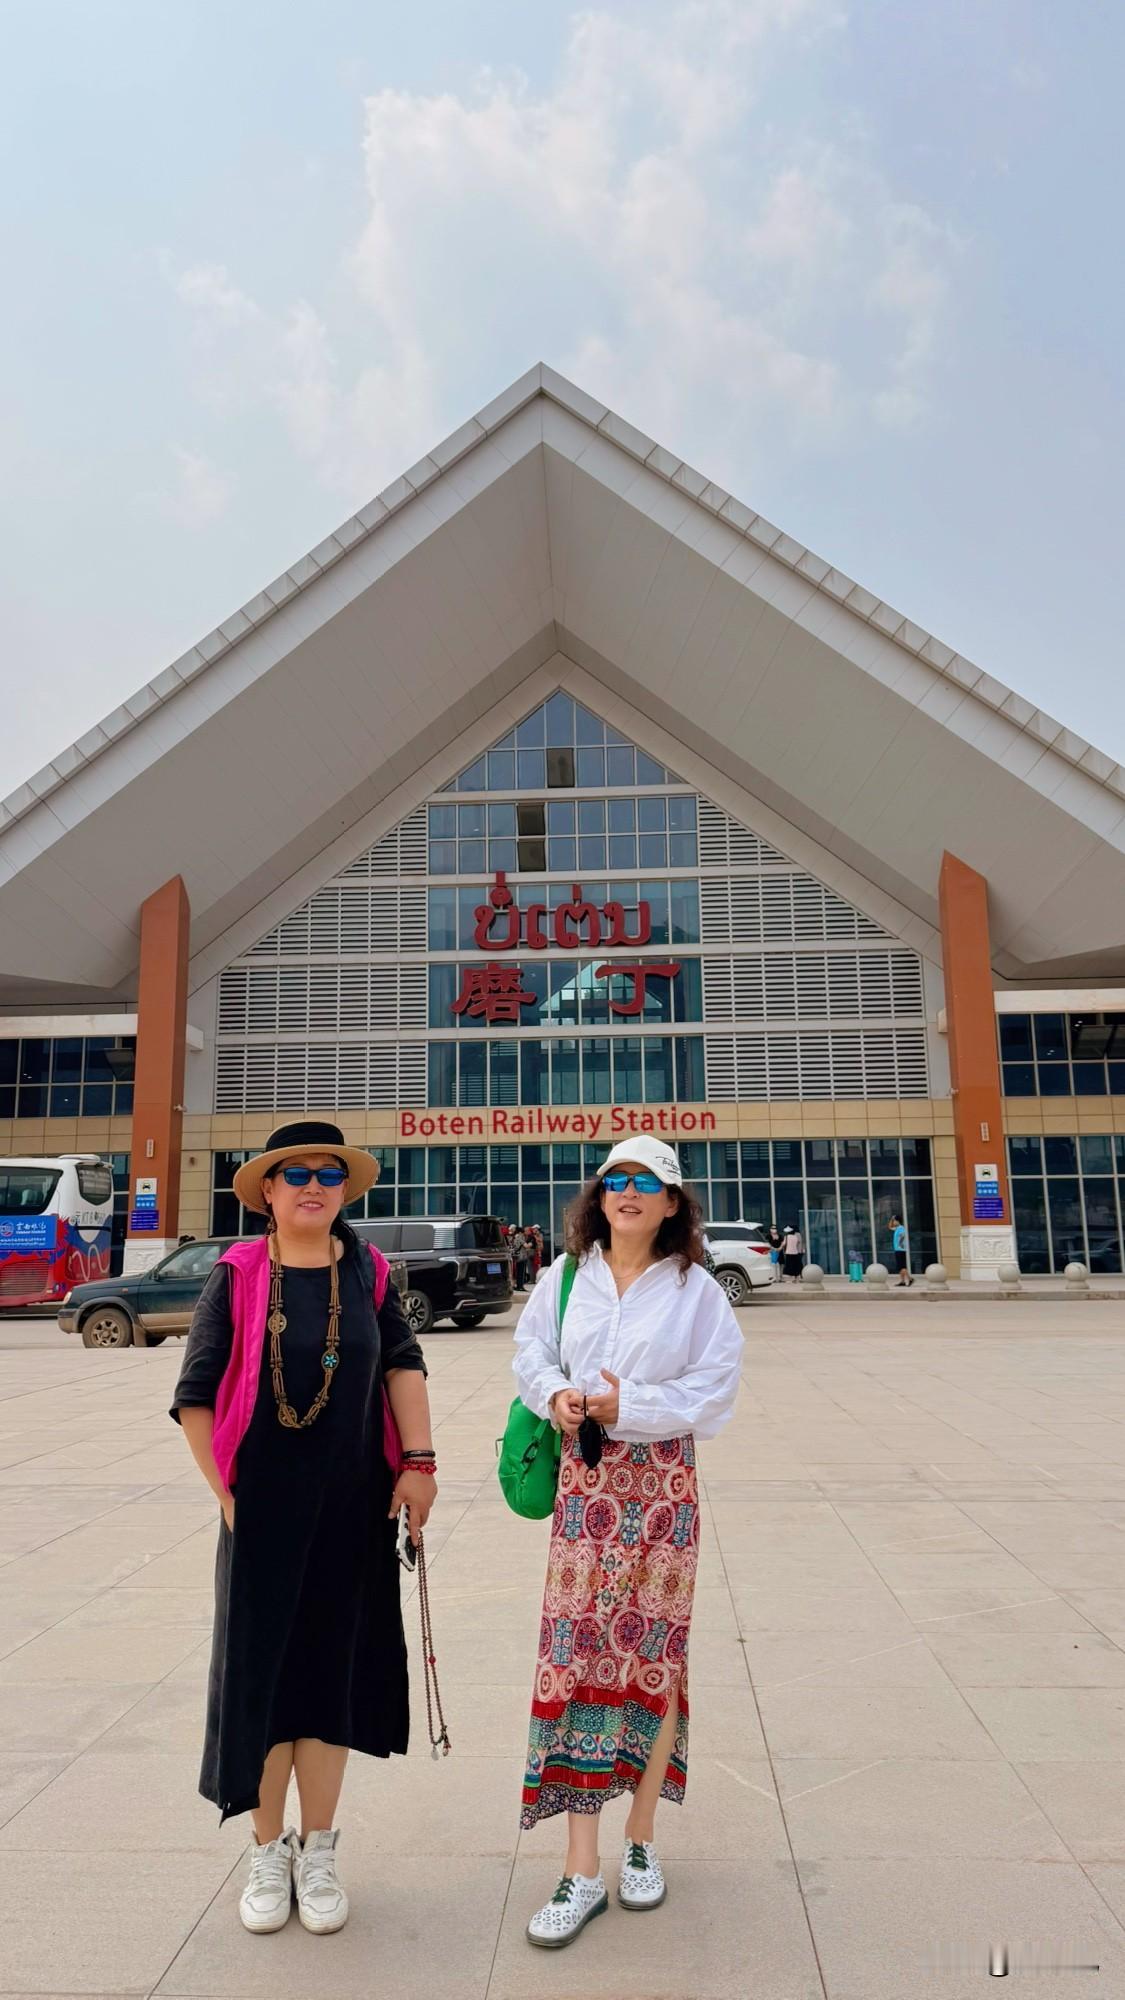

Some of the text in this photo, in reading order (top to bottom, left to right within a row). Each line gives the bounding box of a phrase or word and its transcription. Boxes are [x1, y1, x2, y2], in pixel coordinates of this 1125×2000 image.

[451, 961, 681, 1021] 磨丁
[400, 1106, 716, 1139] Boten Railway Station
